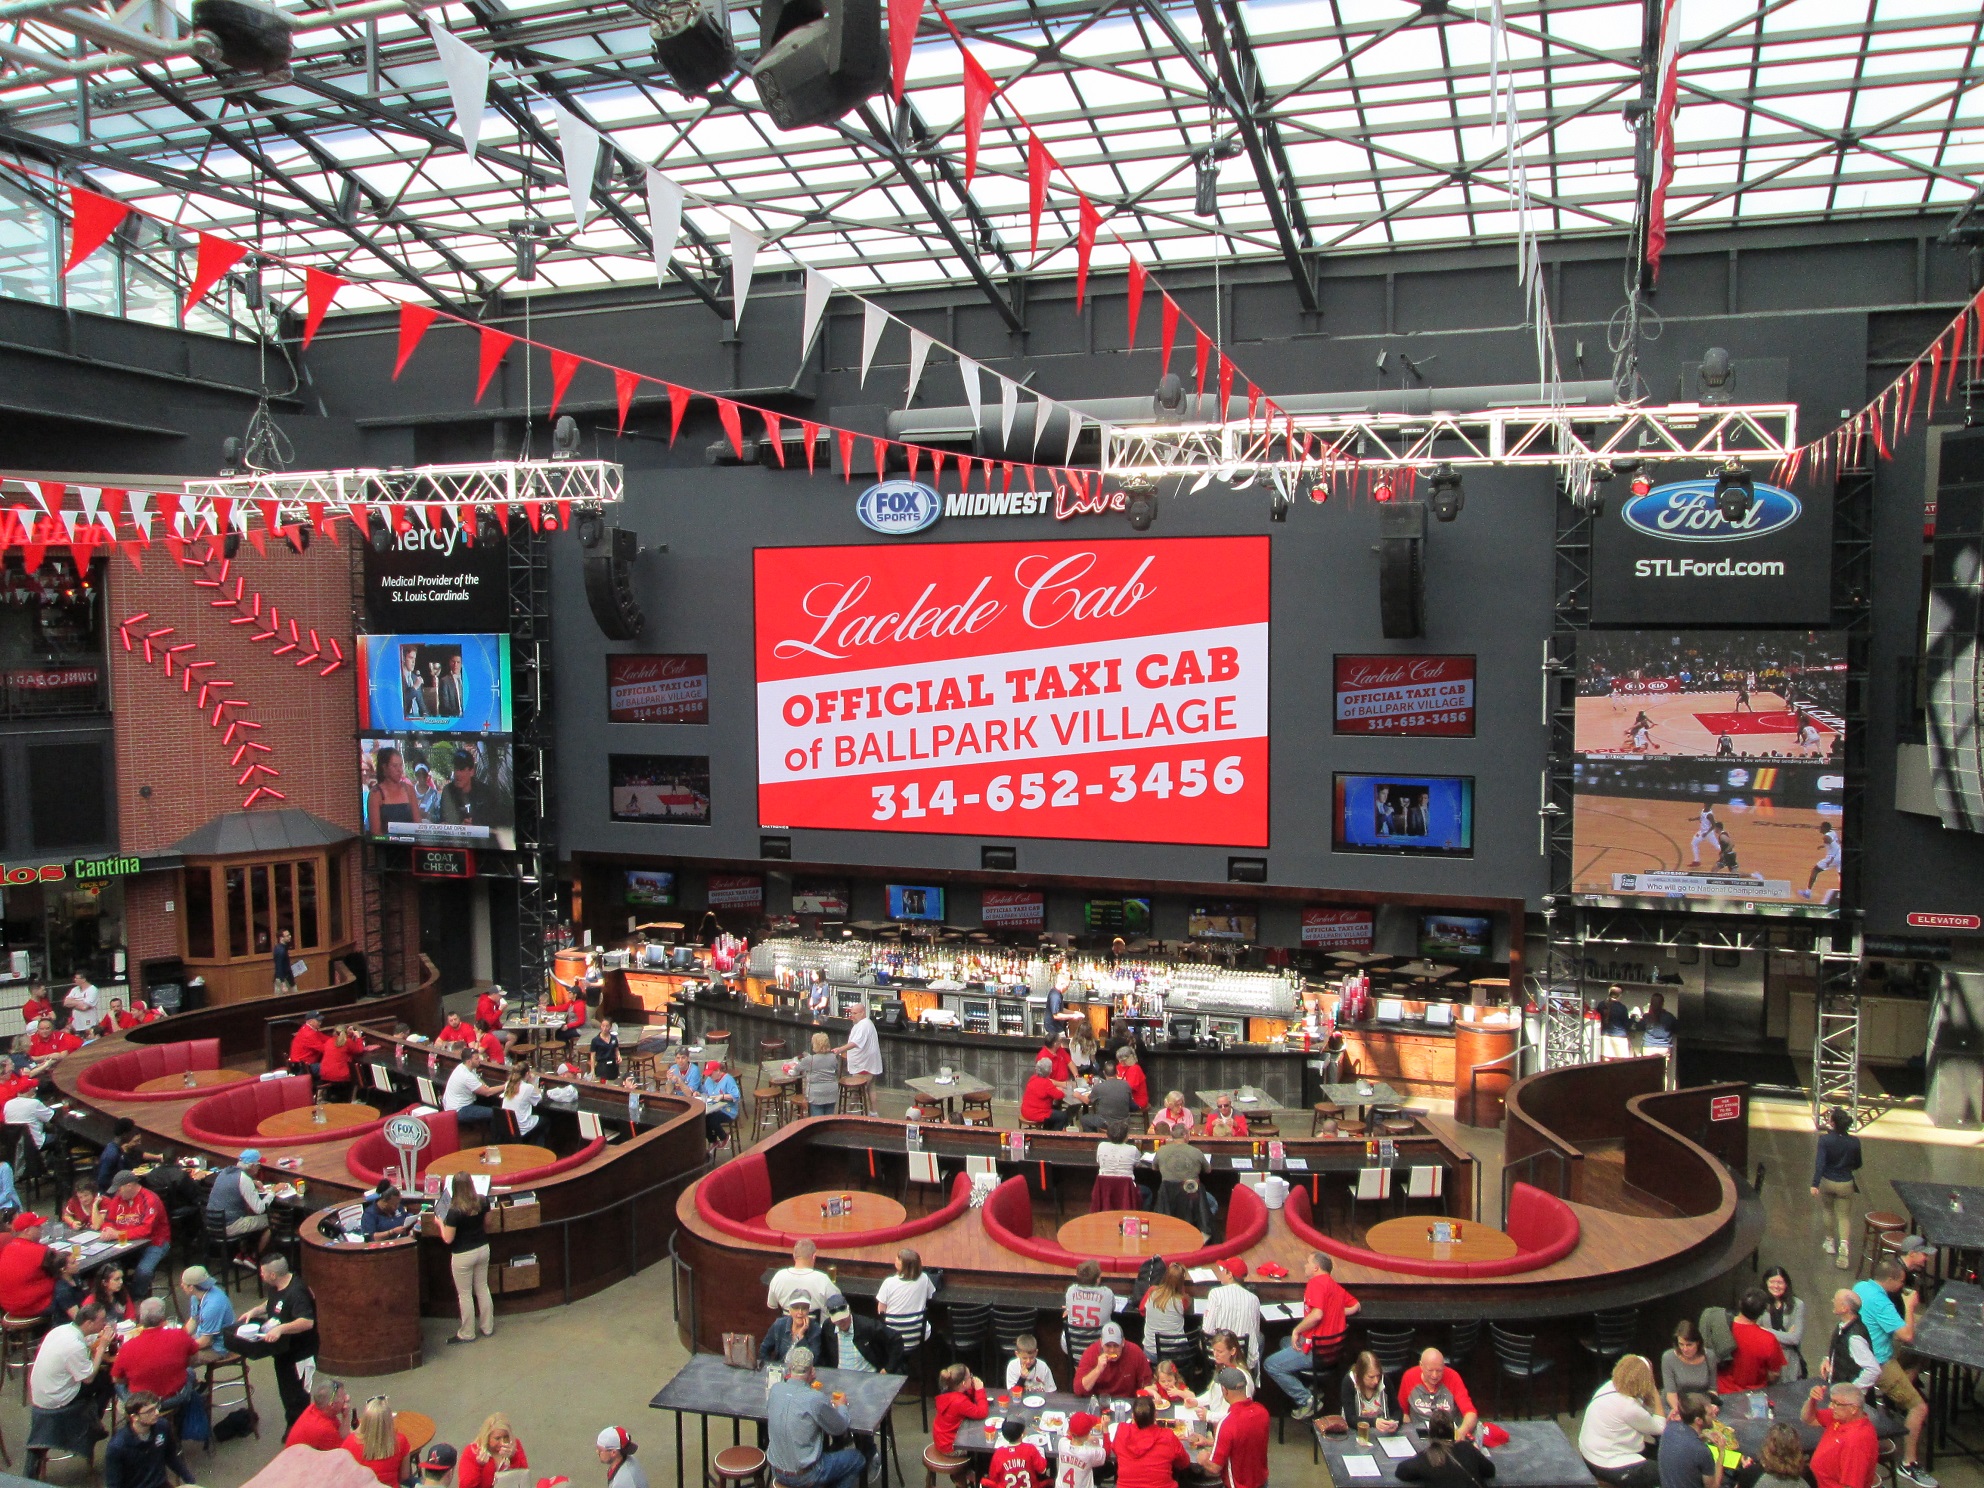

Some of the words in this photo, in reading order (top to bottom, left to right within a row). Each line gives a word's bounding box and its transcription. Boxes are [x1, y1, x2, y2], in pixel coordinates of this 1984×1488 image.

[876, 492, 920, 514] FOX
[944, 491, 1053, 517] MIDWEST
[1054, 485, 1126, 520] Live
[1657, 489, 1765, 530] Ford
[876, 512, 921, 523] SPORTS
[391, 526, 459, 557] ercy
[1634, 558, 1785, 577] STLFord.com
[381, 575, 416, 587] Medical
[417, 574, 452, 587] Provider
[455, 573, 465, 587] of
[465, 573, 480, 585] the
[391, 591, 403, 602] St.
[405, 590, 427, 601] Louis
[428, 589, 470, 601] Cardinals
[773, 575, 1008, 659] Laclede
[1014, 552, 1158, 629] Cab
[1342, 665, 1405, 687] Laclede
[1408, 660, 1446, 680] Cab
[615, 685, 658, 698] OFFICIAL
[659, 682, 682, 692] TAXI
[683, 679, 702, 688] CAB
[782, 673, 995, 728] OFFICIAL
[1005, 658, 1122, 704] TAXI
[1135, 646, 1240, 690] CAB
[1344, 690, 1403, 705] OFFICIAL
[1405, 687, 1436, 698] TAXI
[1439, 684, 1466, 695] CAB
[615, 700, 624, 708] of
[626, 694, 666, 706] BALLPARK
[668, 689, 702, 701] VILLAGE
[1344, 707, 1356, 717] of
[1358, 702, 1415, 716] BALLPARK
[1417, 696, 1465, 710] VILLAGE
[1368, 711, 1467, 730] 314-652-3456
[784, 737, 824, 772] of
[834, 714, 1039, 768] BALLPARK
[1050, 695, 1238, 746] VILLAGE
[871, 755, 1245, 821] 314-652-3456
[75, 857, 140, 878] Cantina
[423, 862, 458, 872] CHECK
[427, 853, 453, 862] COAT
[1688, 884, 1696, 892] to
[1697, 884, 1726, 893] National
[1727, 885, 1784, 896] Championship?
[1917, 916, 1970, 925] ELEVATOR
[397, 1124, 414, 1133] FOX
[1071, 1305, 1101, 1328] 55
[1002, 1459, 1026, 1472] OZUNA
[1004, 1470, 1032, 1488] 23
[1062, 1467, 1075, 1488] 4
